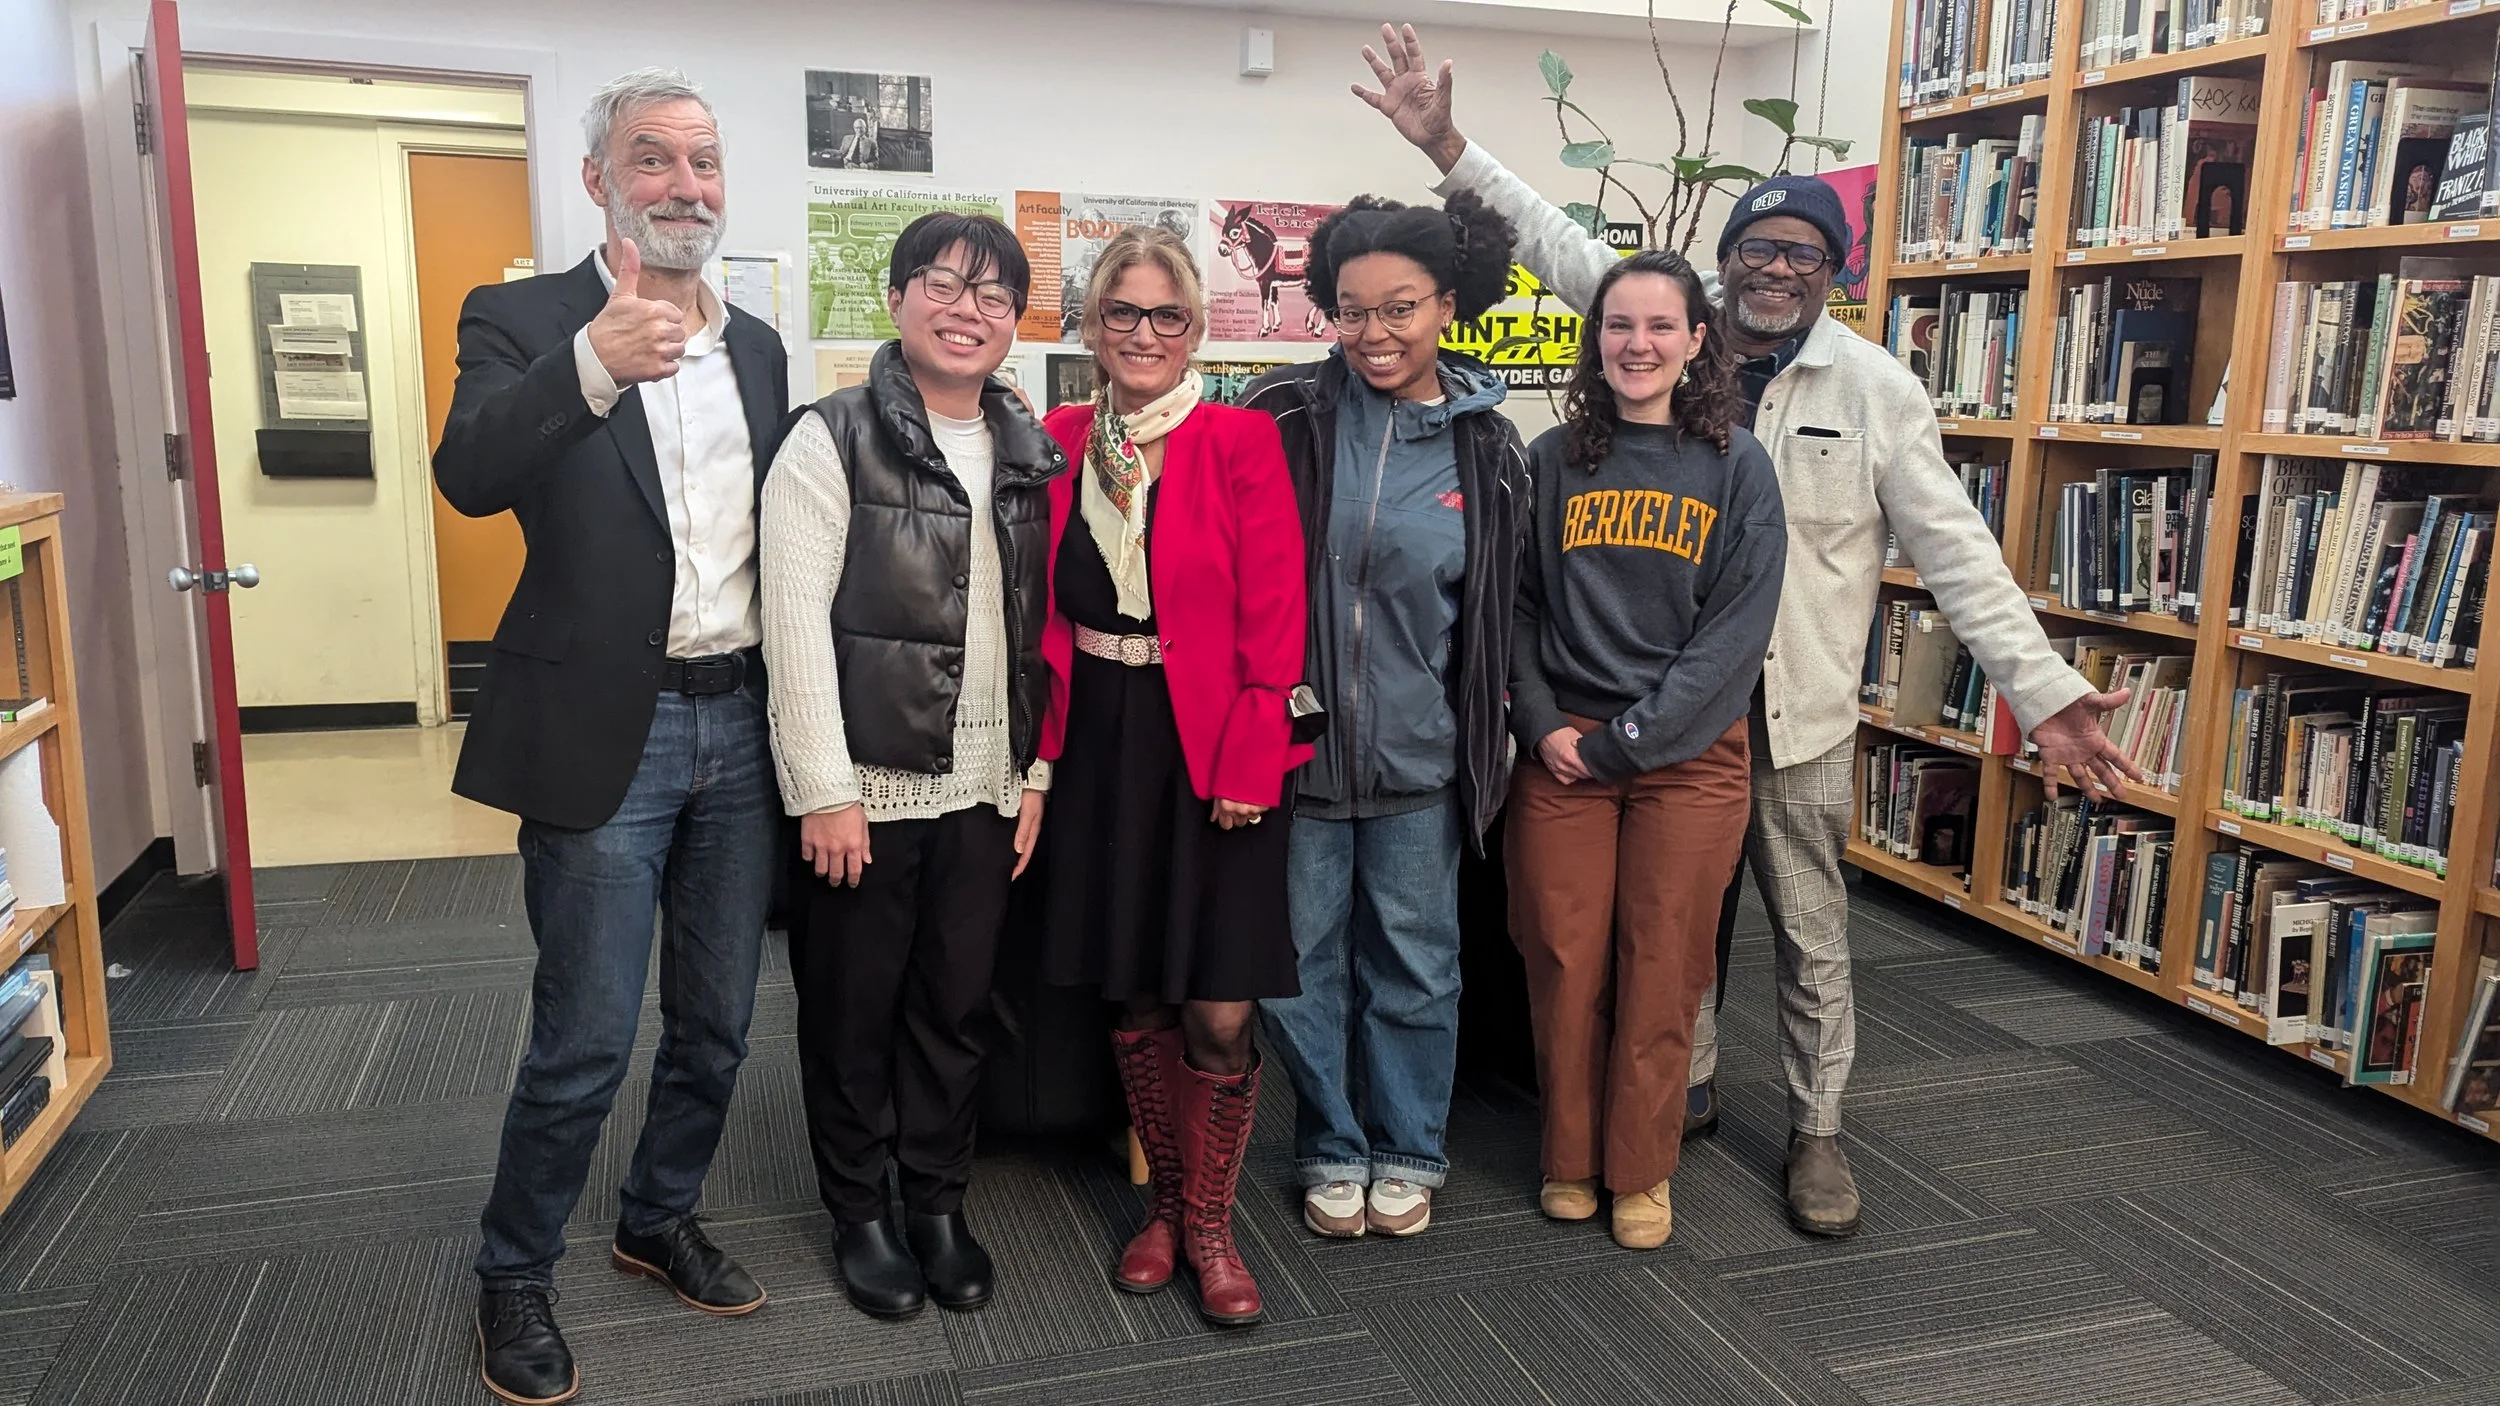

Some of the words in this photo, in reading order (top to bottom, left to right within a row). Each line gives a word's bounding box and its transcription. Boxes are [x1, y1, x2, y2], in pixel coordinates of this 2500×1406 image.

[1946, 7, 1953, 19] BY
[2191, 88, 2234, 117] EROS
[2325, 93, 2336, 121] SOME
[2163, 124, 2173, 149] Erotic
[2321, 121, 2332, 145] CALL
[2344, 105, 2360, 155] GREAT
[2449, 126, 2489, 155] BLACK
[2319, 146, 2328, 158] IT
[2448, 143, 2488, 171] WHITE
[1897, 160, 1907, 207] SPLENDOURS
[2162, 171, 2170, 180] of
[2314, 159, 2327, 193] KITSCH
[2336, 158, 2353, 209] MASKS
[2435, 170, 2479, 203] FRANTZ
[814, 185, 868, 199] University
[872, 189, 883, 197] of
[886, 189, 938, 201] California
[942, 192, 951, 200] at
[955, 193, 998, 205] Berkeley
[1754, 191, 1785, 210] DEUS
[2097, 178, 2108, 213] EROTIC
[2161, 181, 2169, 197] the
[829, 201, 867, 210] Annual
[870, 202, 887, 211] Art
[891, 203, 928, 213] Faculty
[1018, 204, 1034, 214] Art
[1036, 205, 1072, 217] Faculty
[1083, 197, 1118, 206] University
[1118, 198, 1125, 206] of
[1126, 198, 1158, 207] California
[1166, 201, 1197, 210] Berkeley
[1256, 203, 1307, 217] kick
[2160, 198, 2168, 218] East
[1066, 219, 1128, 240] BOO
[2125, 283, 2163, 300] Nude
[2375, 286, 2387, 306] THE
[2340, 288, 2357, 347] MYTHOLOGY
[2482, 299, 2492, 325] IMAGES
[2369, 312, 2384, 358] WAKING
[2453, 334, 2460, 342] of
[2454, 320, 2462, 334] Way
[2481, 325, 2488, 335] OF
[2451, 342, 2459, 353] the
[2475, 335, 2487, 364] HORROR
[2076, 363, 2084, 383] figure
[2447, 353, 2457, 375] Sacred
[2473, 364, 2482, 381] AND
[2362, 362, 2379, 410] DREAM
[2443, 379, 2453, 402] Francis
[2469, 381, 2480, 408] FANTASY
[2272, 477, 2298, 495] OF
[2340, 468, 2353, 503] EDWARD
[2188, 503, 2196, 525] GREAT
[2334, 505, 2345, 532] LEAR'S
[2356, 502, 2365, 521] RAIN
[1562, 490, 1718, 565] BERKELEY
[2271, 510, 2280, 538] American
[2185, 527, 2193, 546] BOOK
[2290, 517, 2303, 558] ABSTRACTION
[2329, 535, 2339, 558] BIRDS
[2348, 523, 2362, 553] FORESTS
[2408, 541, 2414, 551] My
[2184, 547, 2191, 557] OF
[2268, 539, 2277, 558] Woods
[2357, 526, 2378, 571] ANIMAL
[2181, 557, 2189, 585] JEWELS
[2288, 564, 2297, 578] ART
[2290, 557, 2298, 565] IN
[2403, 551, 2412, 572] Quest
[2276, 570, 2287, 594] TREES
[2286, 578, 2296, 591] AND
[2341, 560, 2353, 586] CLOUD
[2282, 591, 2293, 614] NATURE
[2333, 585, 2347, 615] FORESTS
[2344, 574, 2367, 631] ARTISANS
[2392, 585, 2406, 608] Beauty
[2440, 564, 2467, 641] LEAVES
[1889, 604, 1907, 656] COLLAGE
[2267, 678, 2277, 695] THE
[2251, 708, 2260, 730] SUPER
[2265, 696, 2276, 724] SILENT
[2361, 696, 2371, 728] TELEVISION
[2250, 730, 2258, 738] 8
[2261, 724, 2274, 758] CLOWNS
[2360, 728, 2367, 736] IN
[2353, 732, 2361, 761] AMBIENT
[2358, 736, 2366, 762] AMERICA
[2371, 730, 2381, 761] RADICAL
[2413, 736, 2422, 755] Media
[2260, 759, 2268, 768] By
[2412, 755, 2420, 765] Art
[2258, 768, 2267, 789] Walter
[2348, 763, 2359, 800] TELEVISION
[2369, 761, 2378, 783] LIGHT
[2408, 765, 2418, 788] History
[2448, 757, 2463, 807] Supercade
[2381, 761, 2395, 810] EXPANDED
[2433, 781, 2444, 803] Virtual
[2414, 771, 2430, 833] FEEDBACK
[2433, 803, 2441, 815] Art
[2236, 856, 2247, 893] MASTERS
[2235, 893, 2244, 904] OF
[2330, 909, 2339, 934] AMERICAN
[2229, 928, 2239, 946] ART
[2328, 934, 2337, 958] PRIMITIVE
